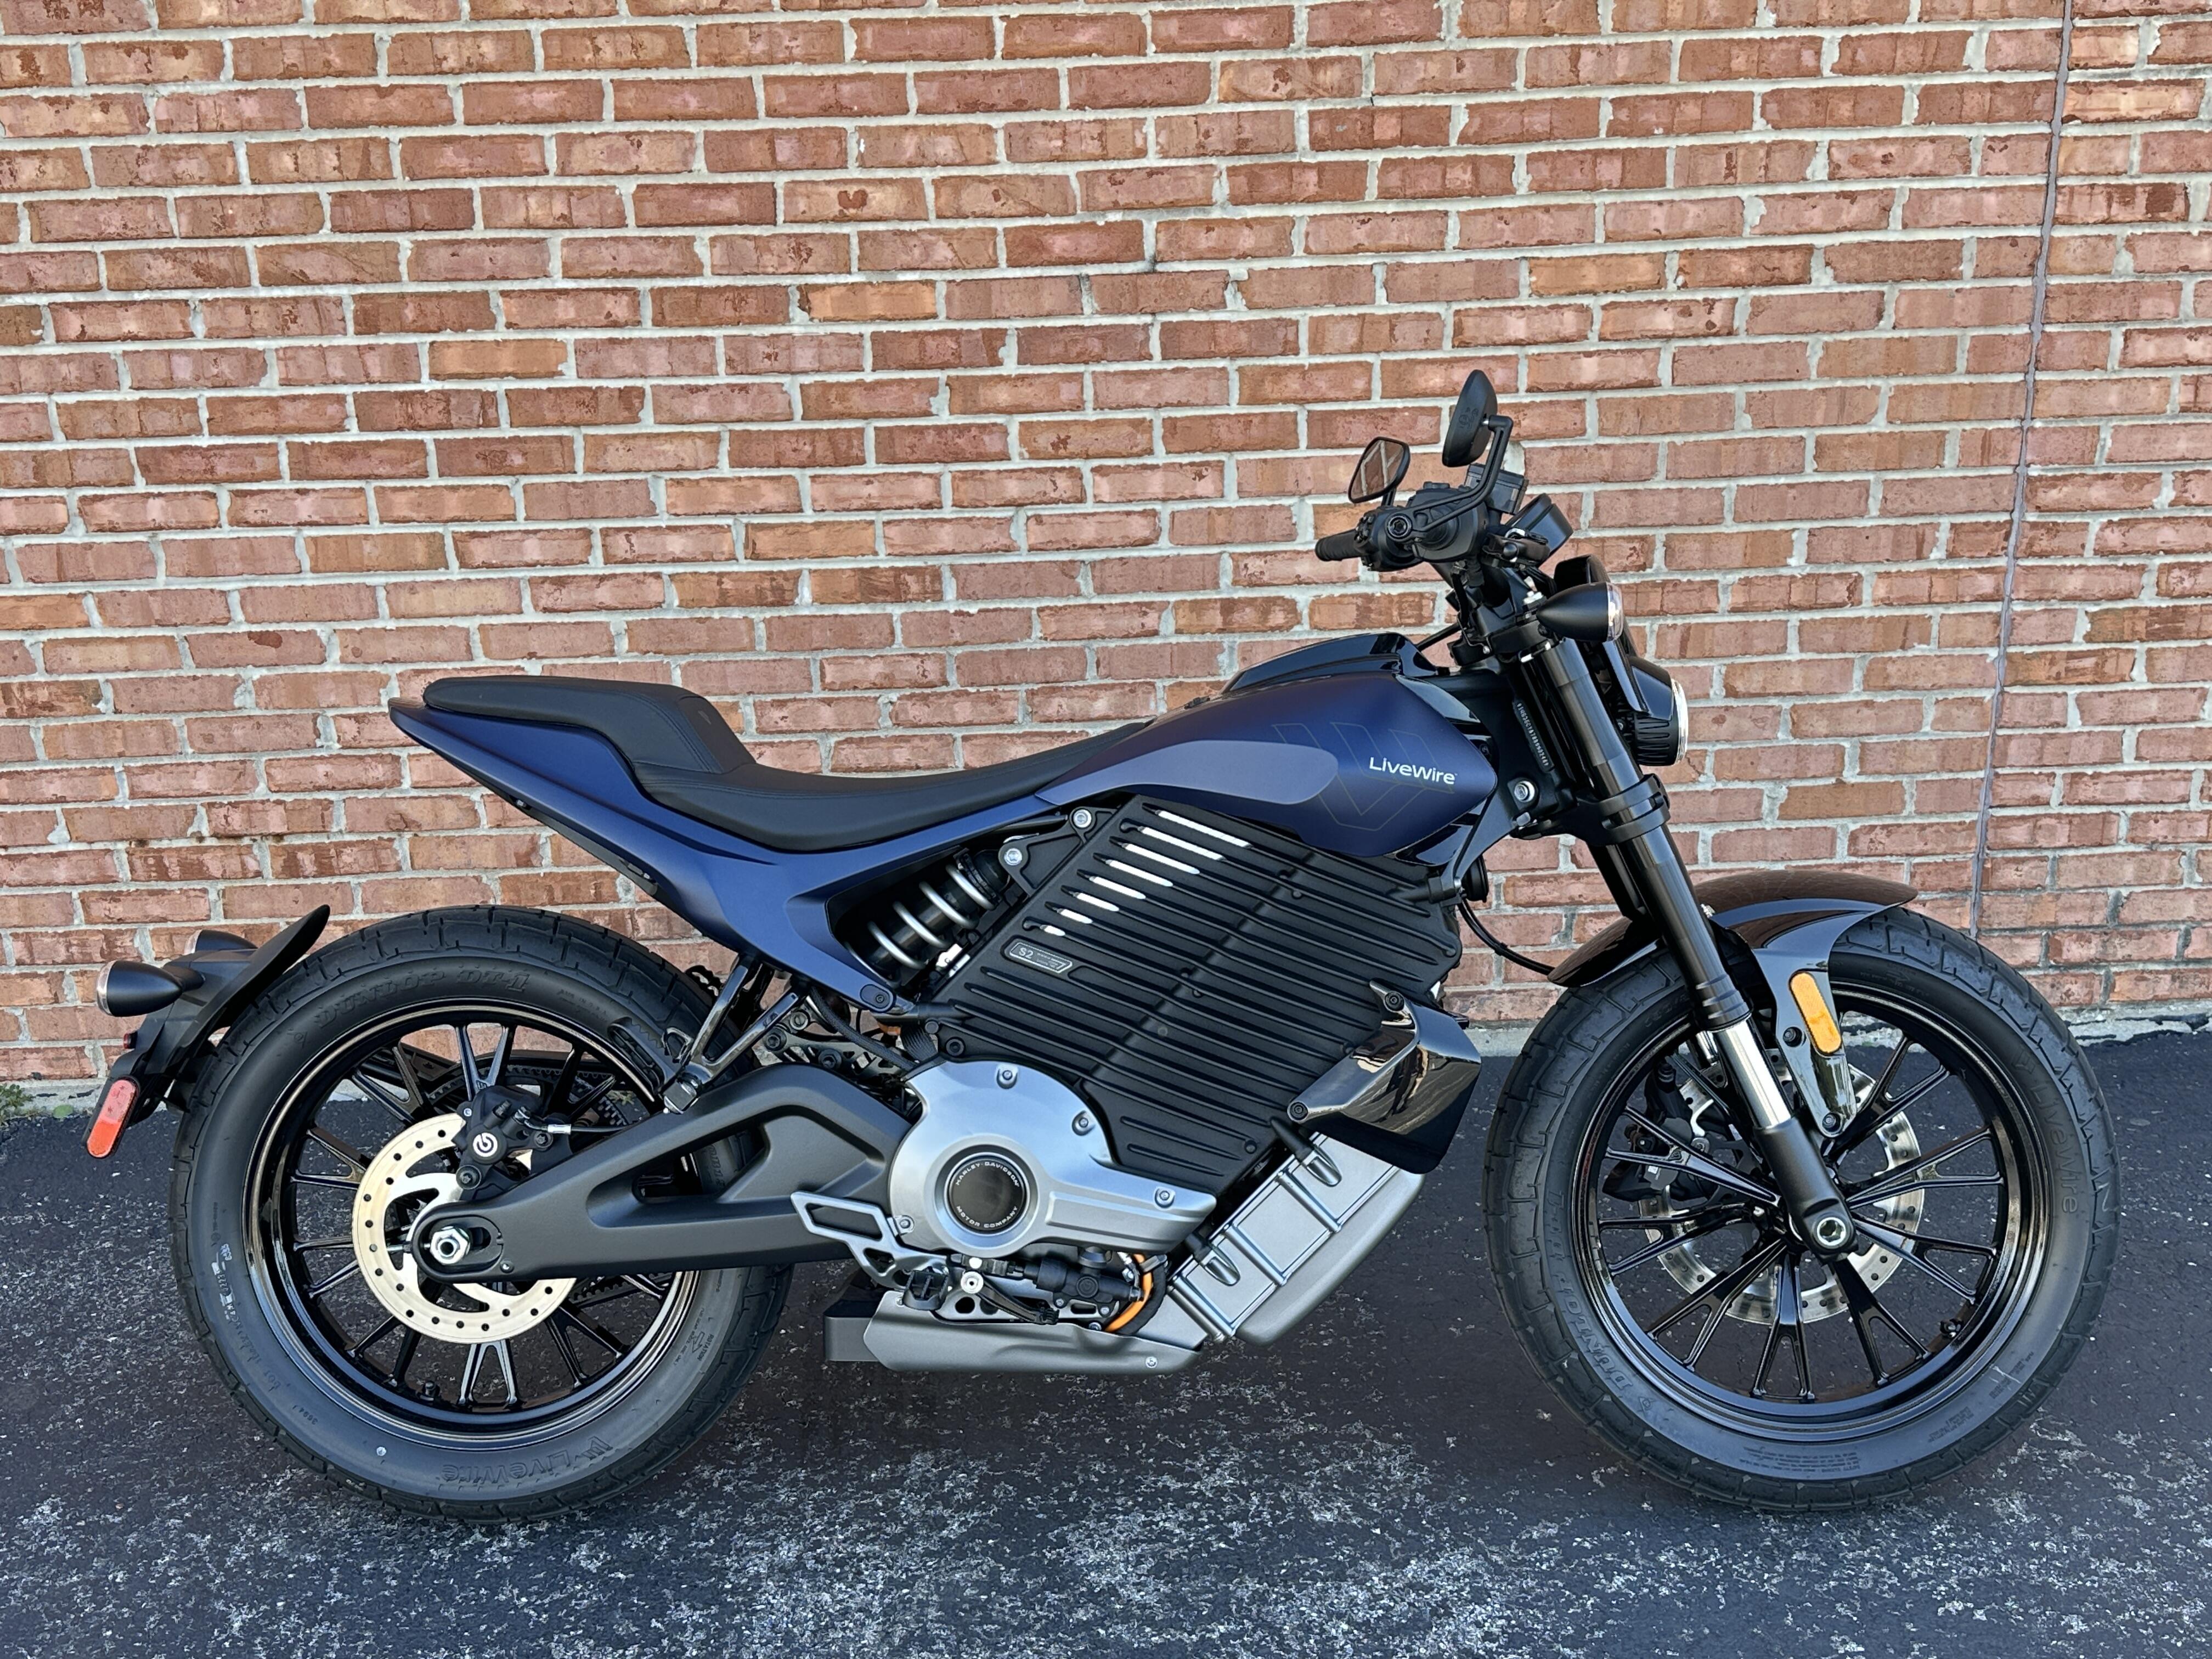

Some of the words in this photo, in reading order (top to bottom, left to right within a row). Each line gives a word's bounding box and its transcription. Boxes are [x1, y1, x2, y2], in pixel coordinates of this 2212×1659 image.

[1369, 757, 1455, 785] LiveWire
[1019, 947, 1034, 959] S2
[314, 970, 447, 1029] DUNLOP
[456, 969, 531, 992] DT-1
[2030, 1084, 2083, 1214] LiveWire
[956, 1206, 980, 1227] MOTOR
[984, 1206, 1018, 1228] COMPANY
[1551, 1272, 1634, 1391] DUNLOP
[442, 1449, 571, 1483] LiveWire
